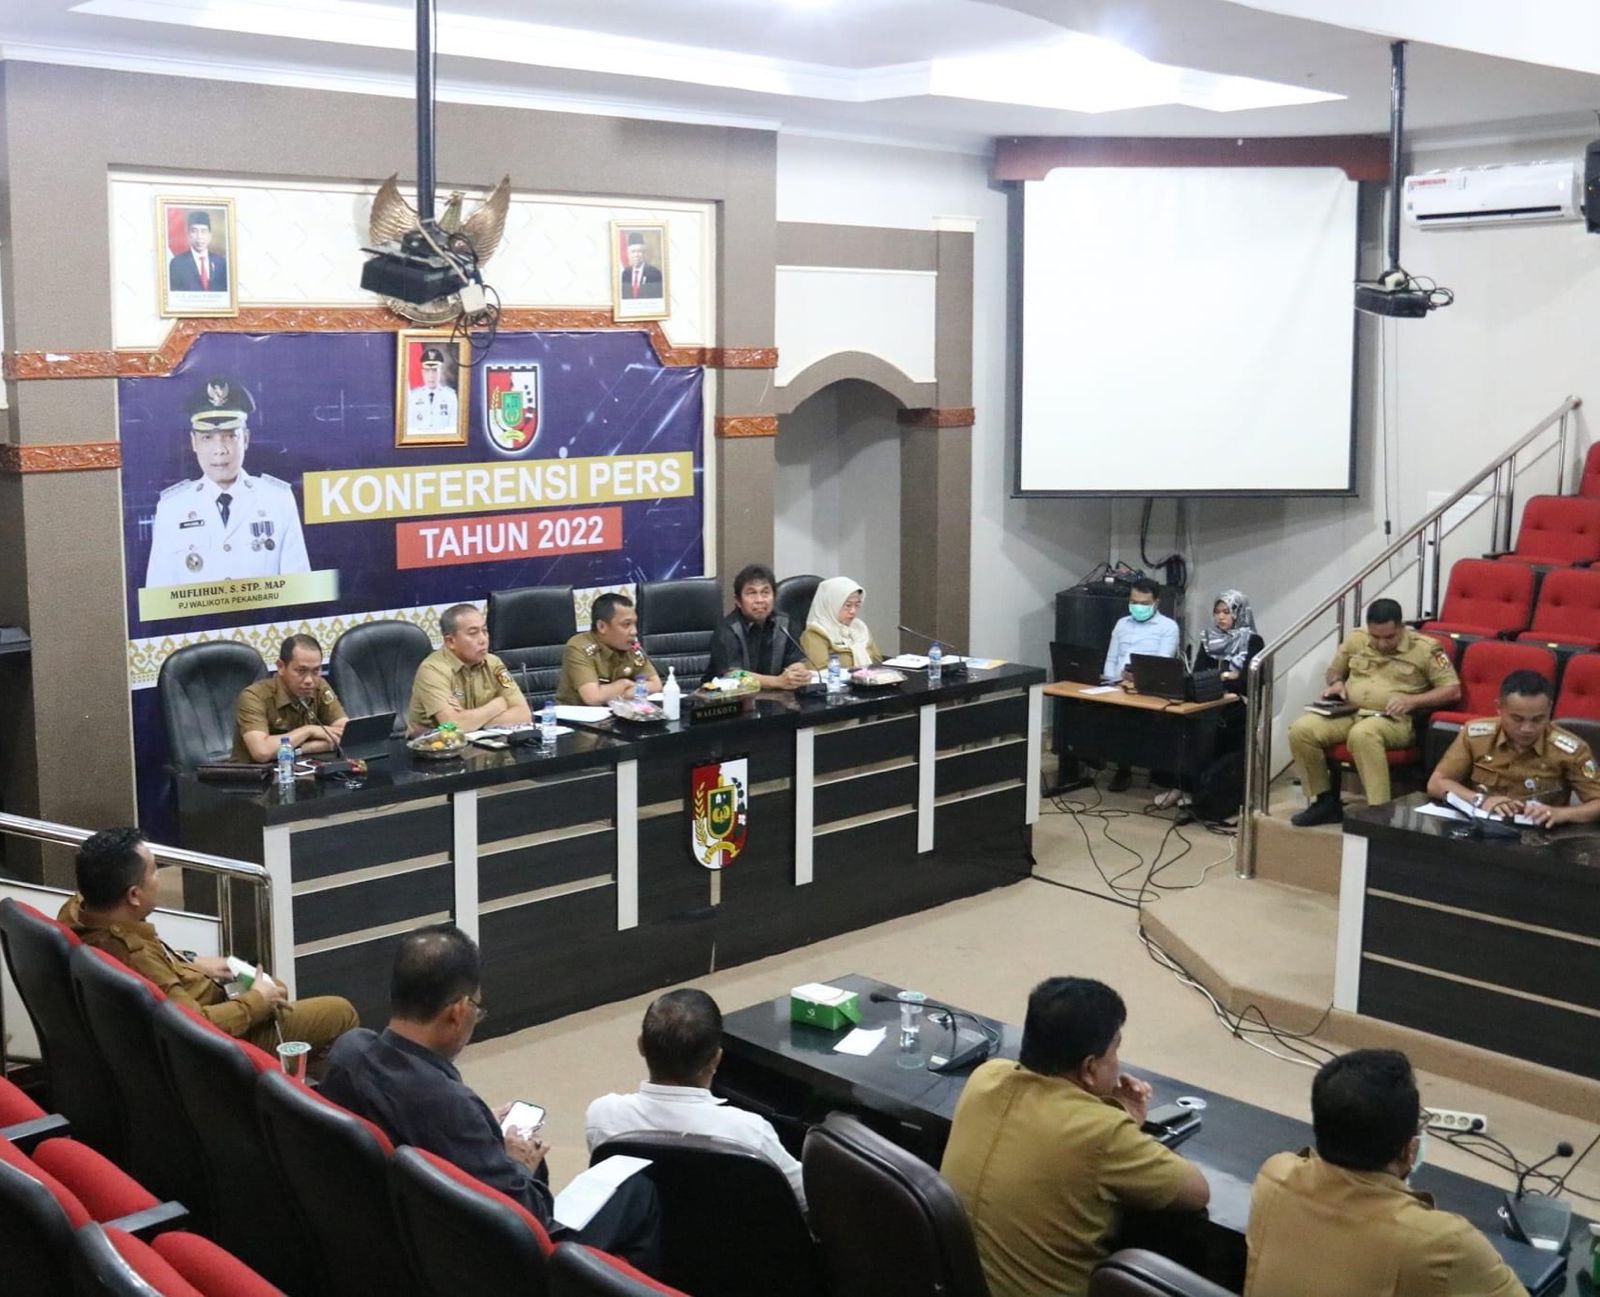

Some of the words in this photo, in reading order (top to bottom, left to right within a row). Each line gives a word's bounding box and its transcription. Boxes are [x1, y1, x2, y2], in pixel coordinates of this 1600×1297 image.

[321, 463, 578, 517] KONFERENSI
[589, 458, 681, 497] PERS
[419, 520, 529, 560] TAHUN
[538, 515, 604, 550] 2022
[265, 580, 286, 590] MAP
[189, 598, 230, 609] WALIKOTA
[231, 593, 280, 604] PEKANBARU
